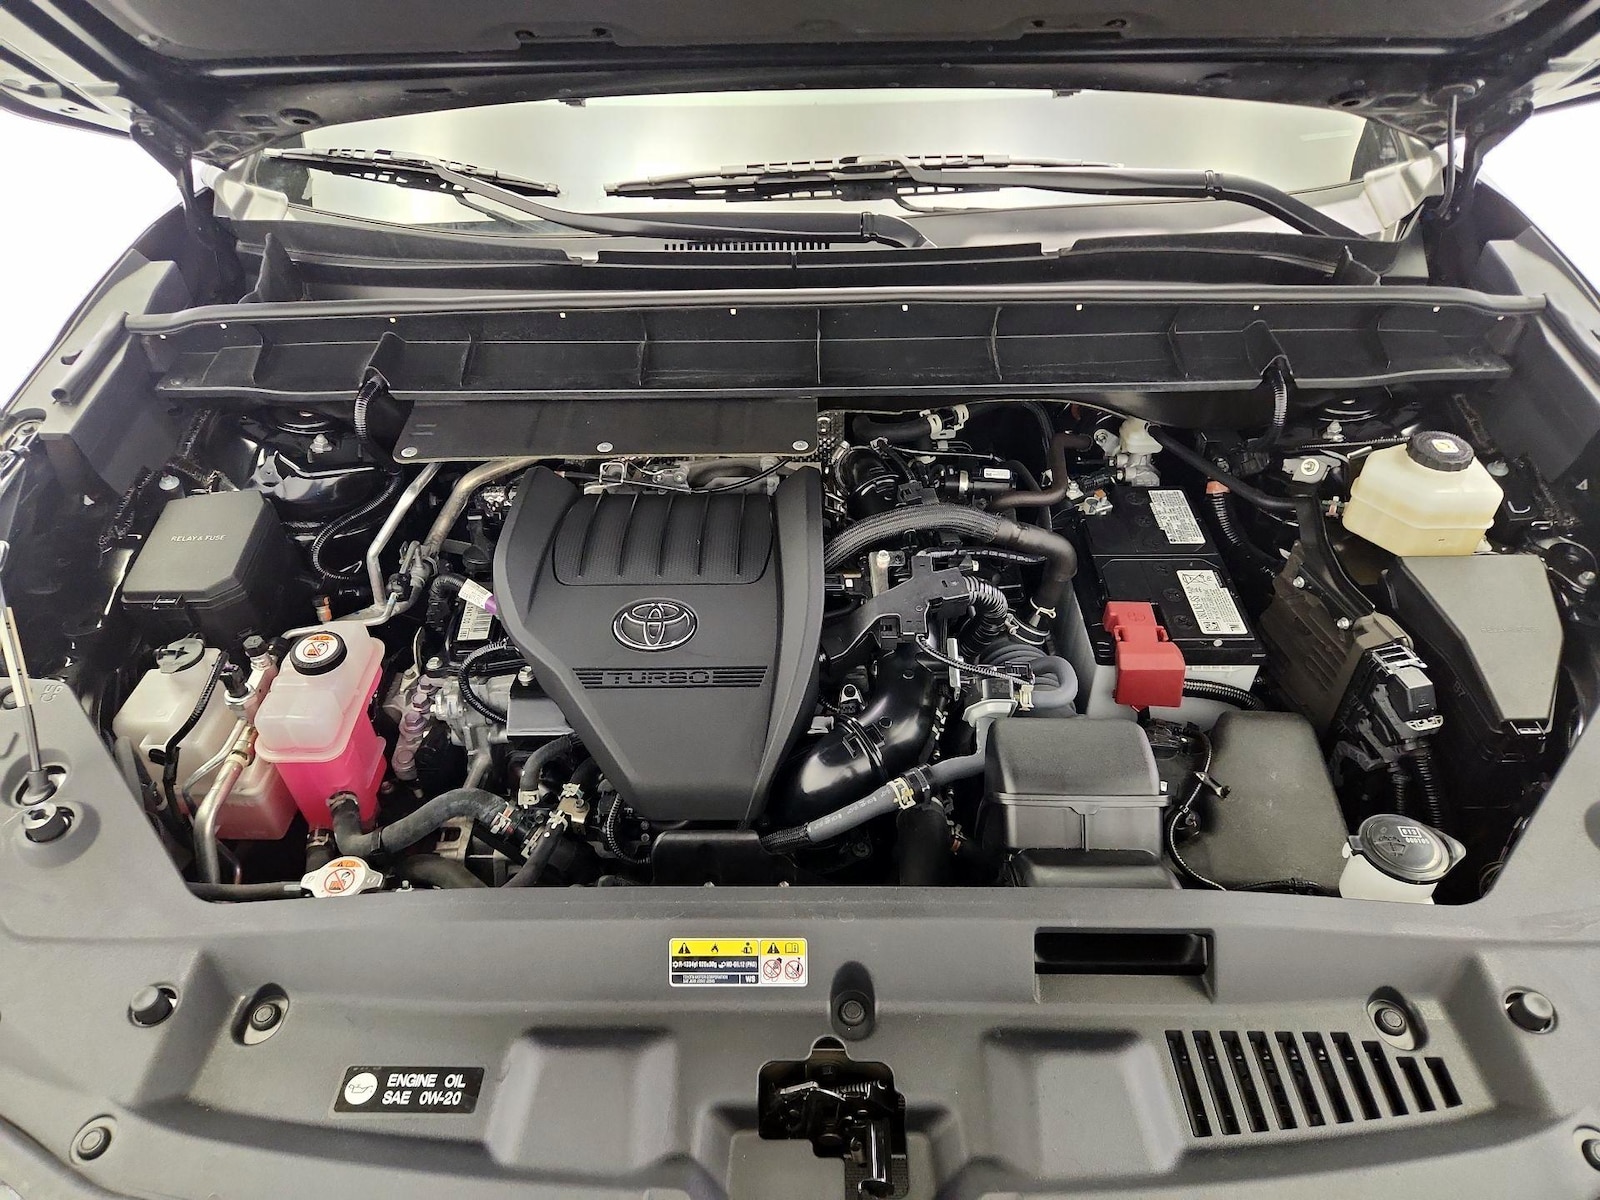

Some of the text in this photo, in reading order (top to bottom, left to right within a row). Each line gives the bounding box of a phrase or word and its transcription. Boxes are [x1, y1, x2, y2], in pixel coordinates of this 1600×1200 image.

[606, 671, 710, 685] TURBO
[386, 1073, 466, 1088] ENGINE OIL
[381, 1090, 462, 1106] SAE 0W-20
